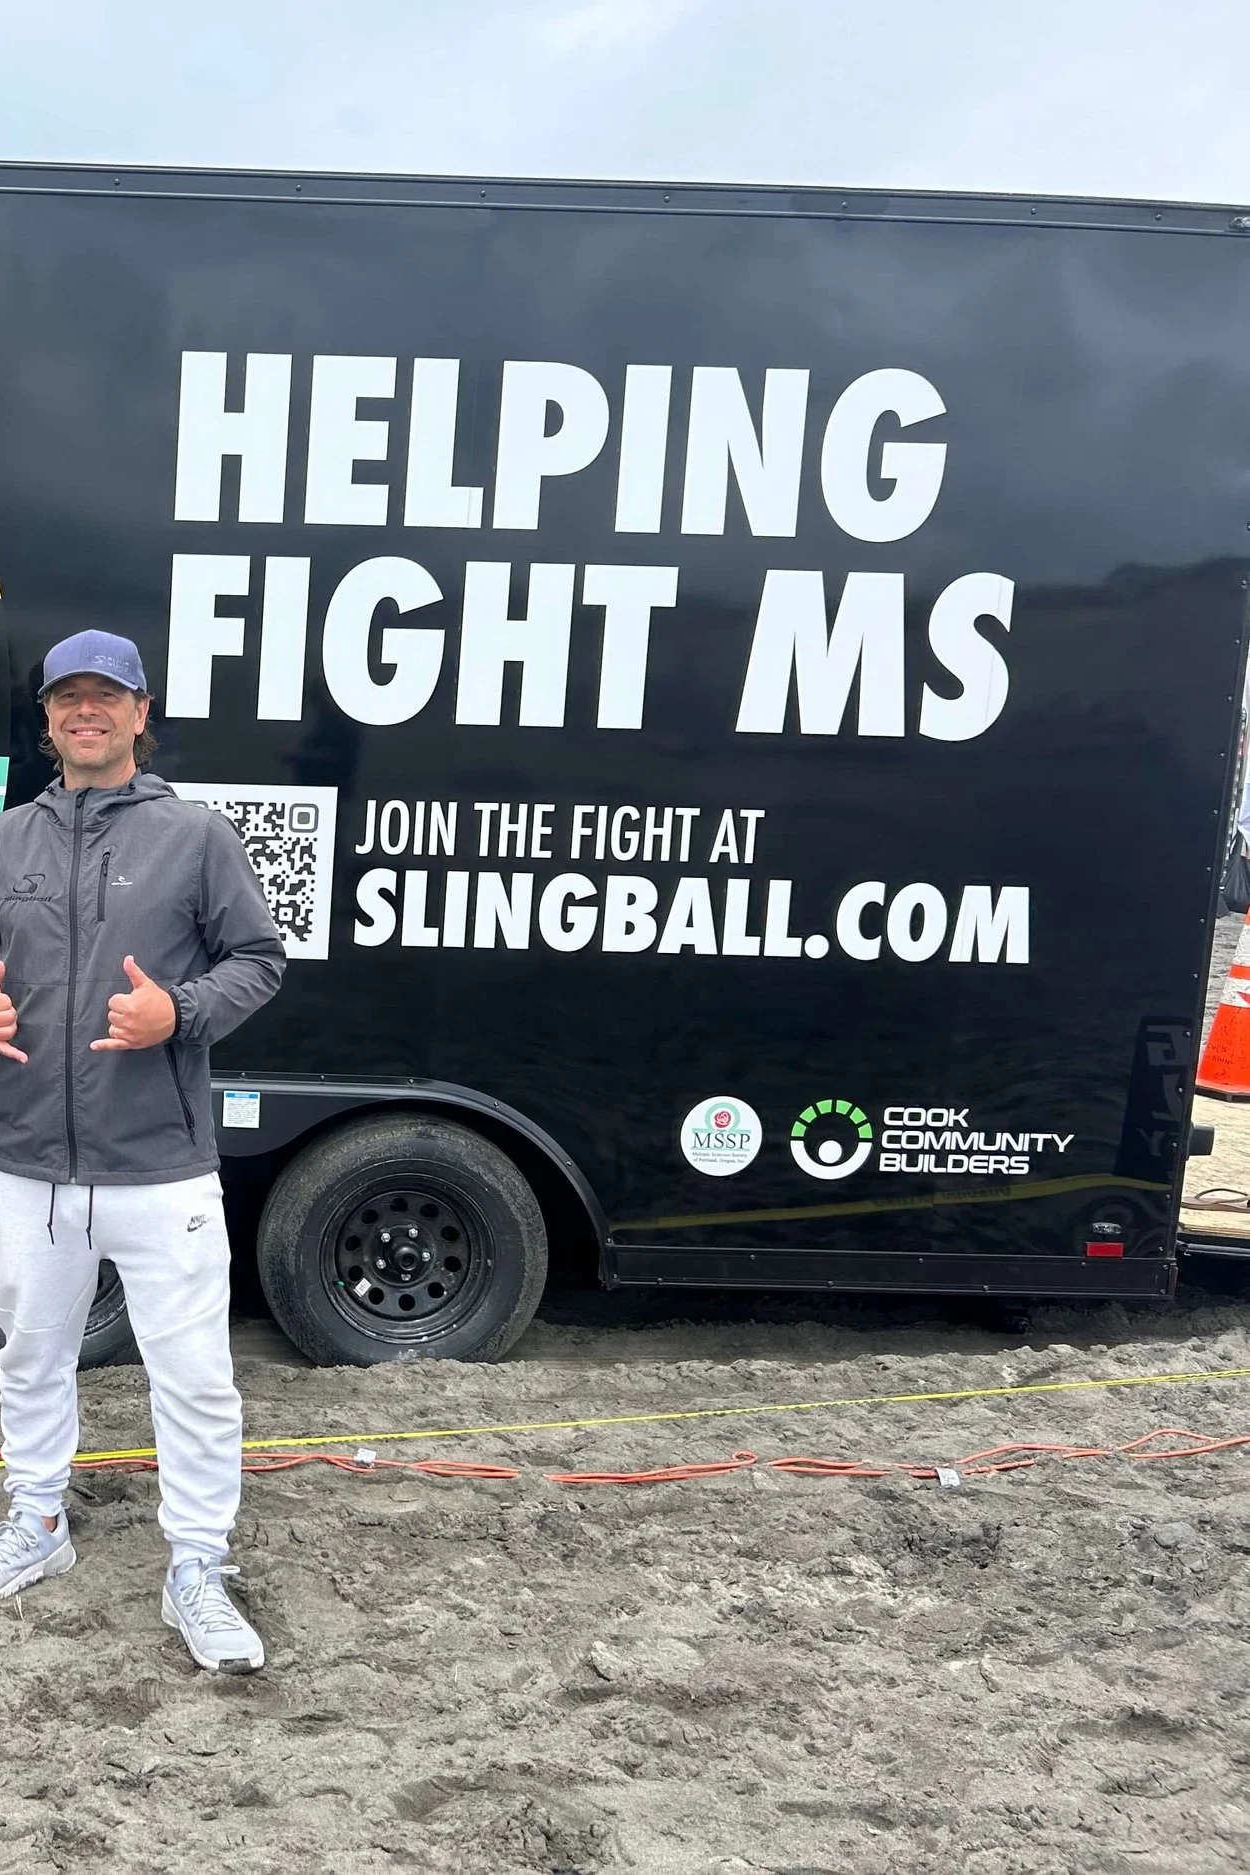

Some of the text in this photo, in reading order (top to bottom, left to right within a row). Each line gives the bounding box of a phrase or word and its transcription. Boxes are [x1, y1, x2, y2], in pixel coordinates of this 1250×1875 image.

[174, 350, 948, 543] HELPING
[165, 553, 1014, 742] FIGHT MS
[355, 799, 765, 864] JOIN THE FIGHT AT
[353, 868, 1030, 964] SLINGBALL.COM
[883, 1106, 970, 1128] COOK
[692, 1132, 751, 1149] MSSP
[881, 1129, 1075, 1153] COMMUNITY
[879, 1153, 1030, 1175] BUILDERS
